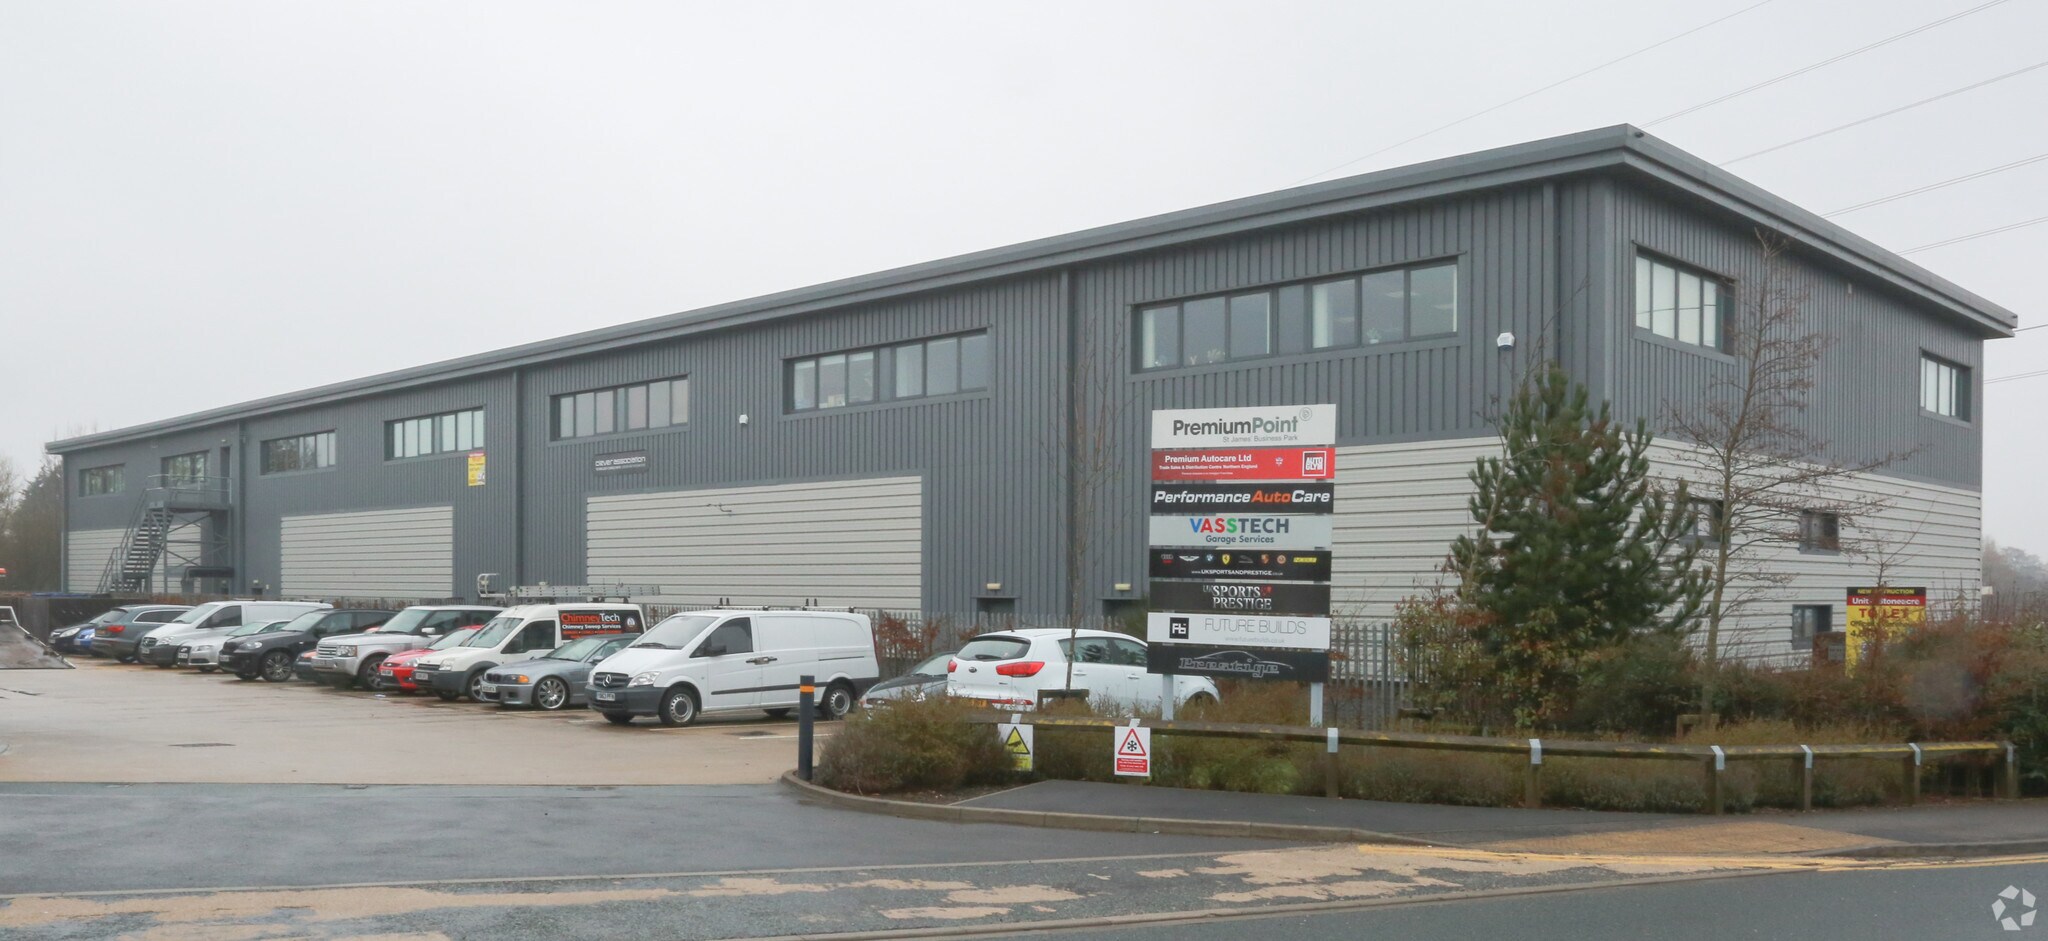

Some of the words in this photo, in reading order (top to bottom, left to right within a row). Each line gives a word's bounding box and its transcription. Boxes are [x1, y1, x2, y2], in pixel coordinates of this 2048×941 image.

[1253, 434, 1281, 442] Business
[1165, 455, 1199, 463] Premium
[1201, 454, 1236, 462] Autocare
[1238, 454, 1252, 462] Ltd
[1190, 518, 1289, 533] VASSTECH
[1205, 535, 1237, 544] Garage
[1239, 535, 1275, 543] Services
[1212, 585, 1261, 598] SPORTS
[1212, 596, 1272, 610] PRESTIGE
[1852, 597, 1869, 605] Unit
[1859, 607, 1877, 618] TO
[1204, 618, 1255, 632] FUTURE
[1259, 620, 1306, 634] BUILDS
[1179, 657, 1279, 678] Prestige
